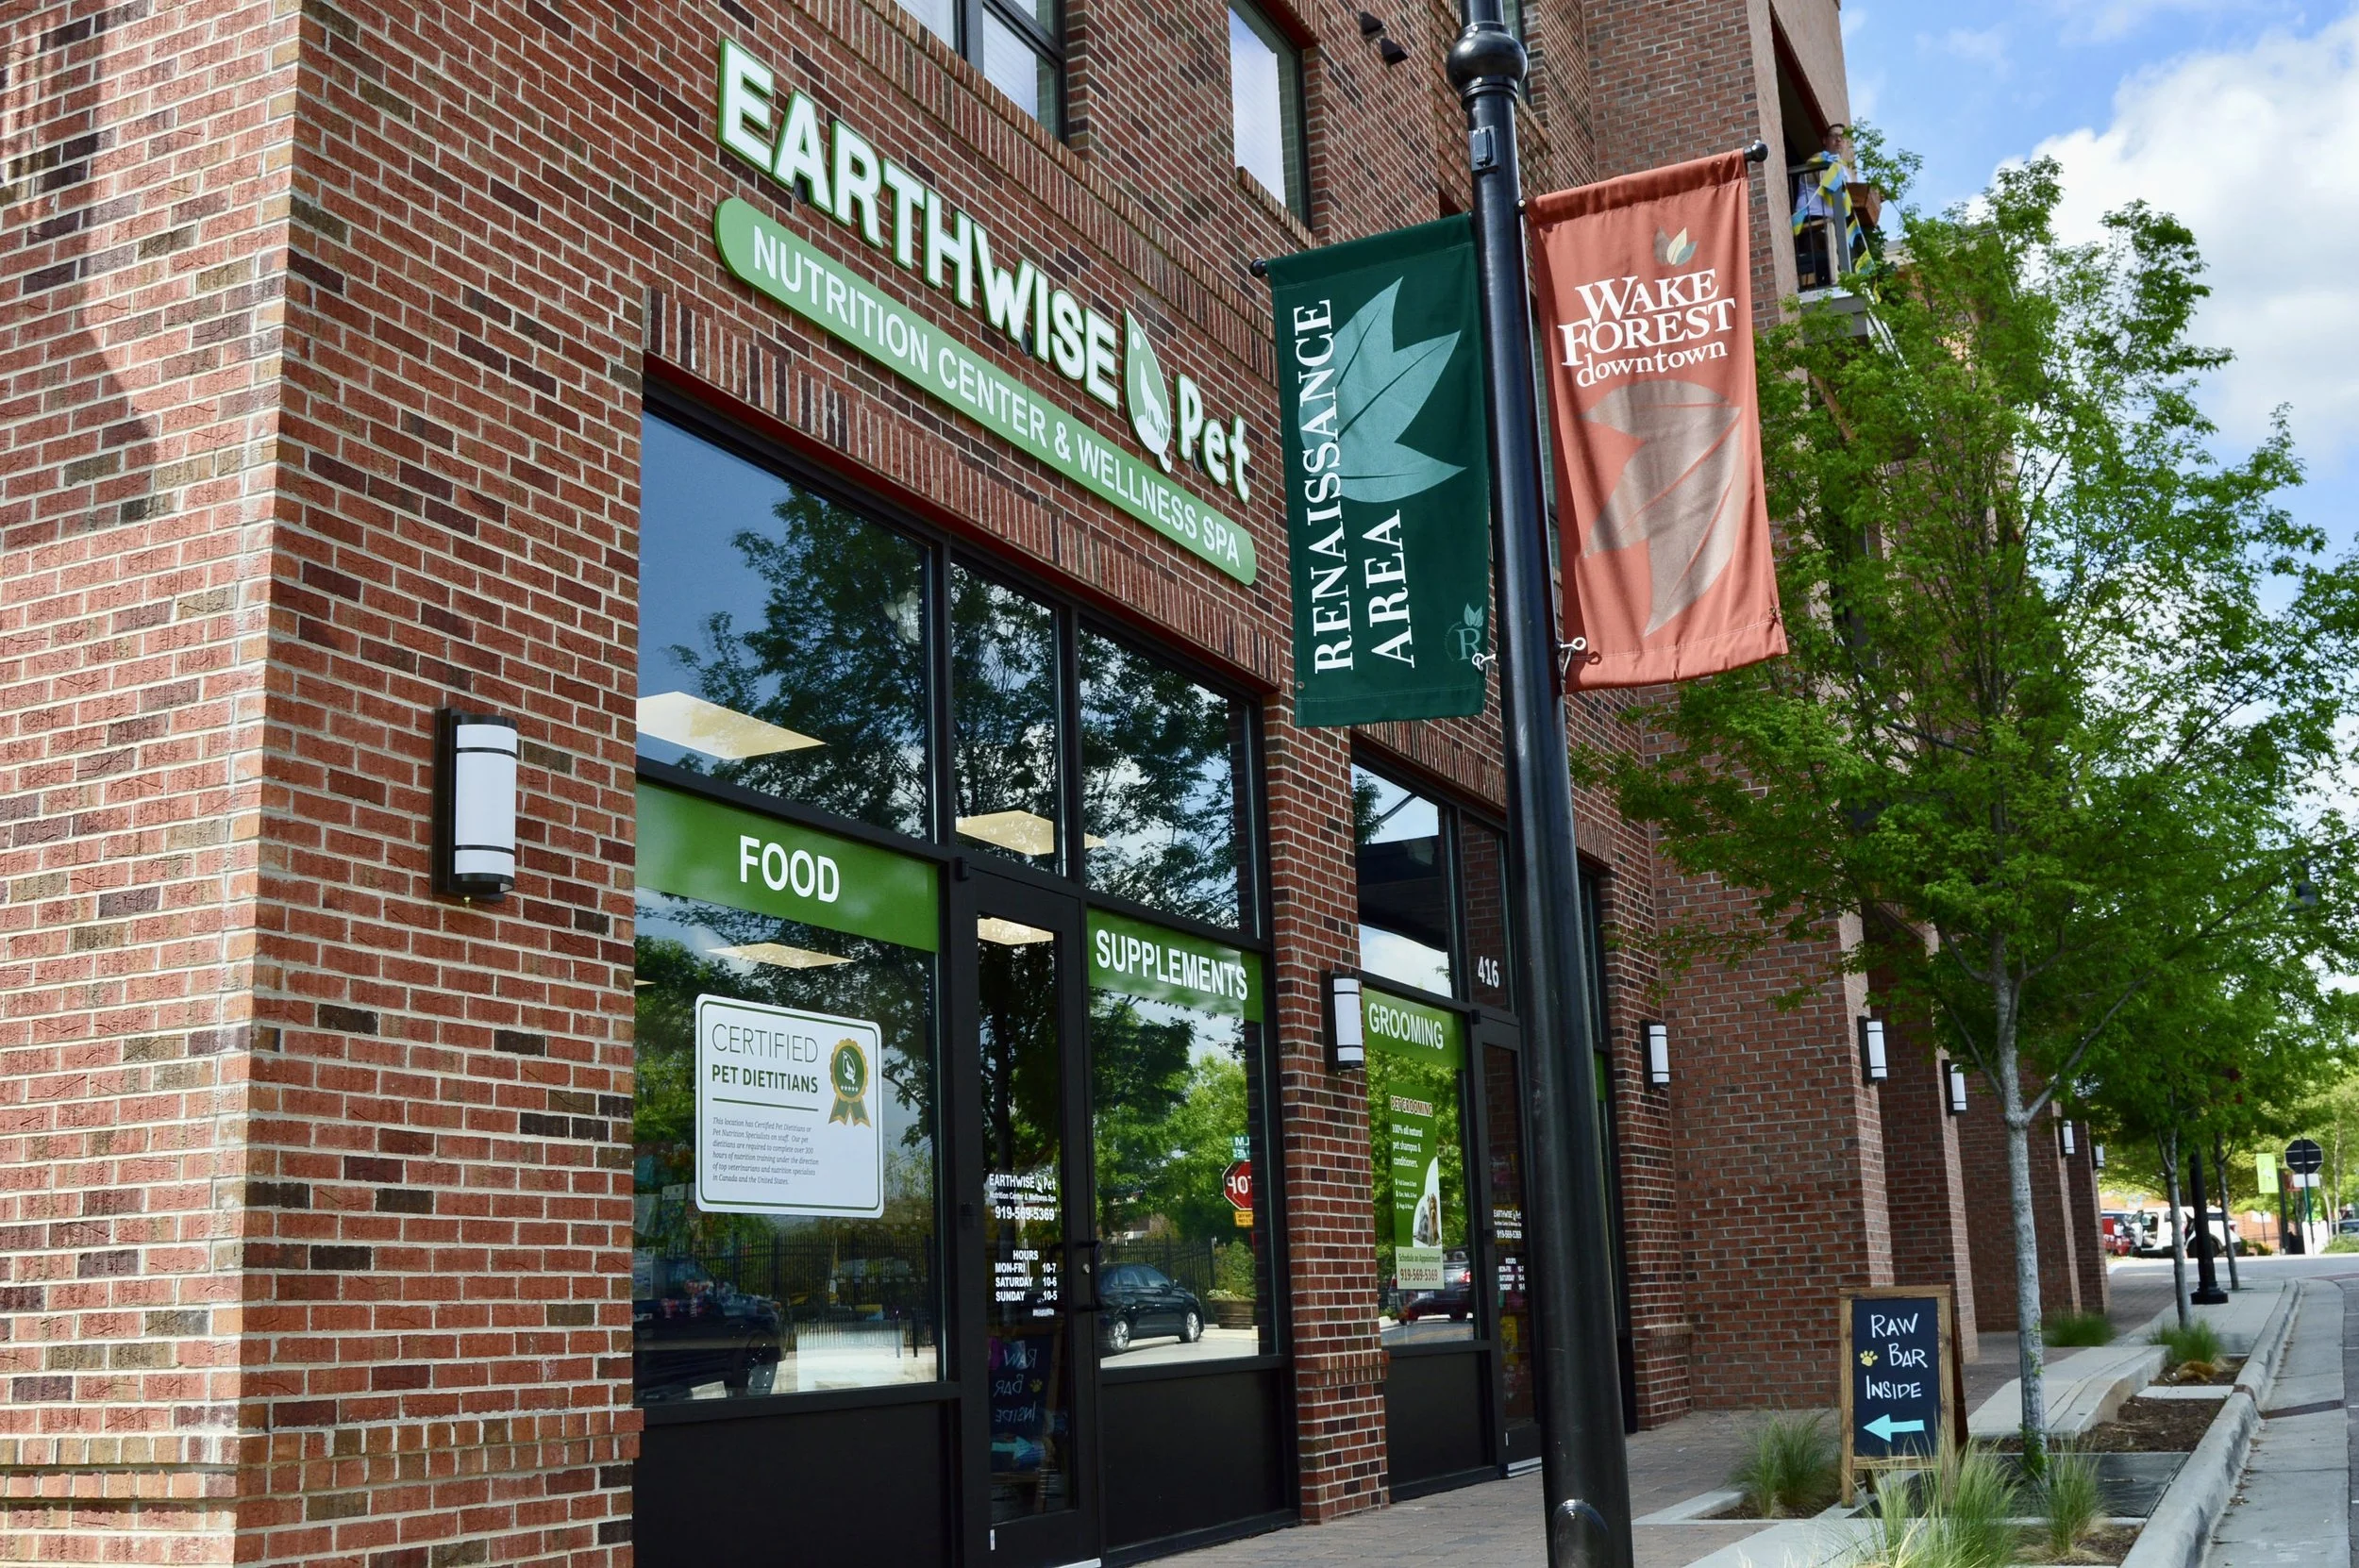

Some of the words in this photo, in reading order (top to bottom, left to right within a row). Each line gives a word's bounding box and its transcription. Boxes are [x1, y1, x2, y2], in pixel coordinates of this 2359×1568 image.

[720, 38, 1119, 409] EARTHWISE
[1177, 374, 1250, 504] Pet
[1575, 269, 1719, 325] WAKE
[1558, 298, 1736, 366] FOREST
[1577, 341, 1728, 388] downtown
[753, 225, 929, 375] NUTRITION
[938, 346, 1047, 449] CENTER
[1054, 421, 1072, 462] &
[1077, 434, 1197, 540] WELLNESS
[1202, 515, 1240, 568] SPA
[1293, 298, 1353, 675] RENAISSANCE
[1364, 509, 1414, 668] AREA
[739, 834, 840, 904] FOOD
[1096, 927, 1248, 1002] SUPPLEMENTS
[1478, 956, 1499, 988] 416
[1368, 1002, 1444, 1050] GROOMING
[711, 1024, 819, 1063] CERTIFIED
[711, 1063, 739, 1084] PET
[743, 1067, 818, 1094] DIETITIANS
[1390, 1095, 1401, 1112] PET
[1402, 1097, 1433, 1118] GROOMING
[713, 1117, 723, 1125] This
[724, 1118, 744, 1126] location
[754, 1121, 774, 1130] Certified
[784, 1124, 805, 1132] Dietitians
[722, 1129, 745, 1138] Nutrition
[745, 1131, 770, 1141] Specialists
[712, 1140, 736, 1149] dietitians
[745, 1143, 766, 1151] required
[772, 1145, 793, 1154] complete
[728, 1152, 734, 1160] of
[756, 1155, 776, 1163] training
[799, 1157, 819, 1165] direction
[712, 1162, 718, 1170] of
[719, 1163, 727, 1172] top
[792, 1168, 816, 1176] specialists
[719, 1174, 737, 1182] Canada
[988, 1174, 1035, 1188] EARTHWISE
[1043, 1176, 1056, 1191] Pet
[989, 1191, 1009, 1200] Nutrition
[1009, 1192, 1024, 1200] Center
[1029, 1193, 1047, 1201] Wellness
[1048, 1194, 1057, 1203] Spa
[995, 1205, 1055, 1221] 919-569-5369
[995, 1262, 1026, 1273] MON-FRI
[1042, 1262, 1057, 1273] 10-7
[1012, 1250, 1039, 1260] HOURS
[995, 1276, 1033, 1287] SATURDAY
[1042, 1276, 1057, 1287] 10-6
[995, 1291, 1025, 1302] SUNDAY
[1043, 1290, 1058, 1301] 10-5
[1871, 1312, 1919, 1338] RAW
[1888, 1343, 1928, 1368] BAR
[1866, 1375, 1922, 1400] INSIDE
